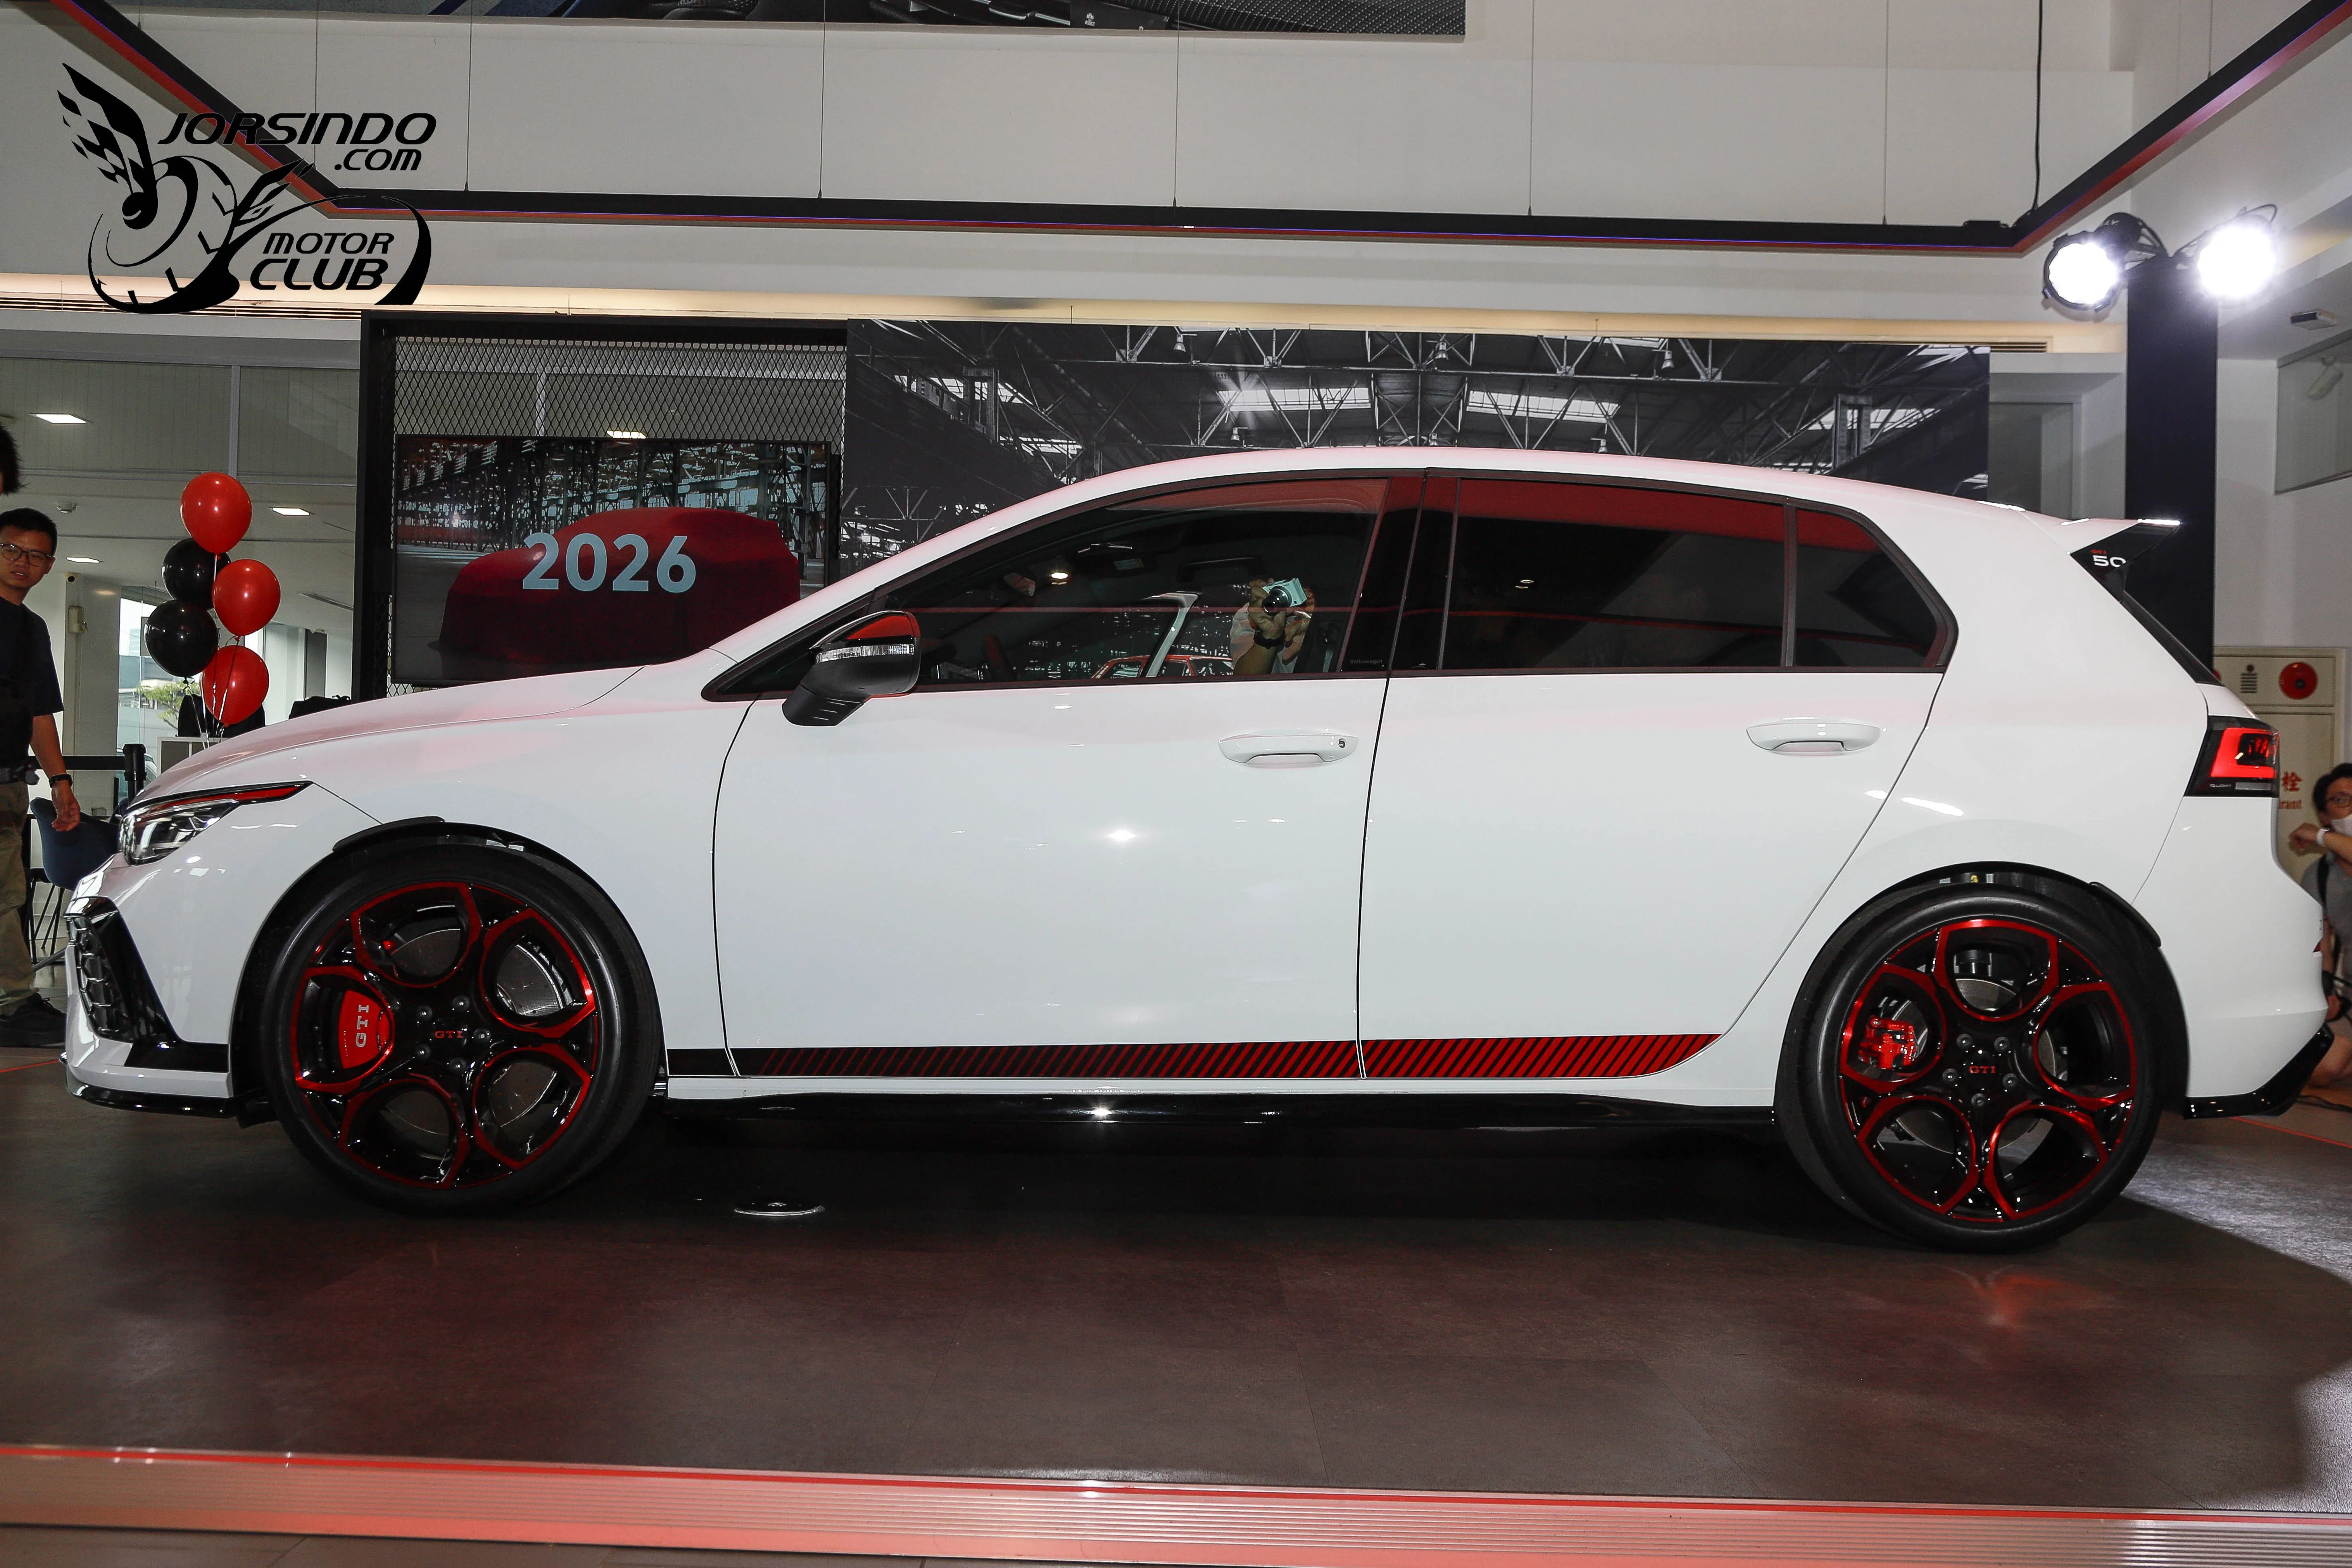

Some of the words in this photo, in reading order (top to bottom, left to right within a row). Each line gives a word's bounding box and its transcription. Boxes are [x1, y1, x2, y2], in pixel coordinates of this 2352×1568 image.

[522, 532, 697, 593] 2026
[356, 1004, 370, 1047] GTI
[1969, 1066, 1996, 1074] GTI
